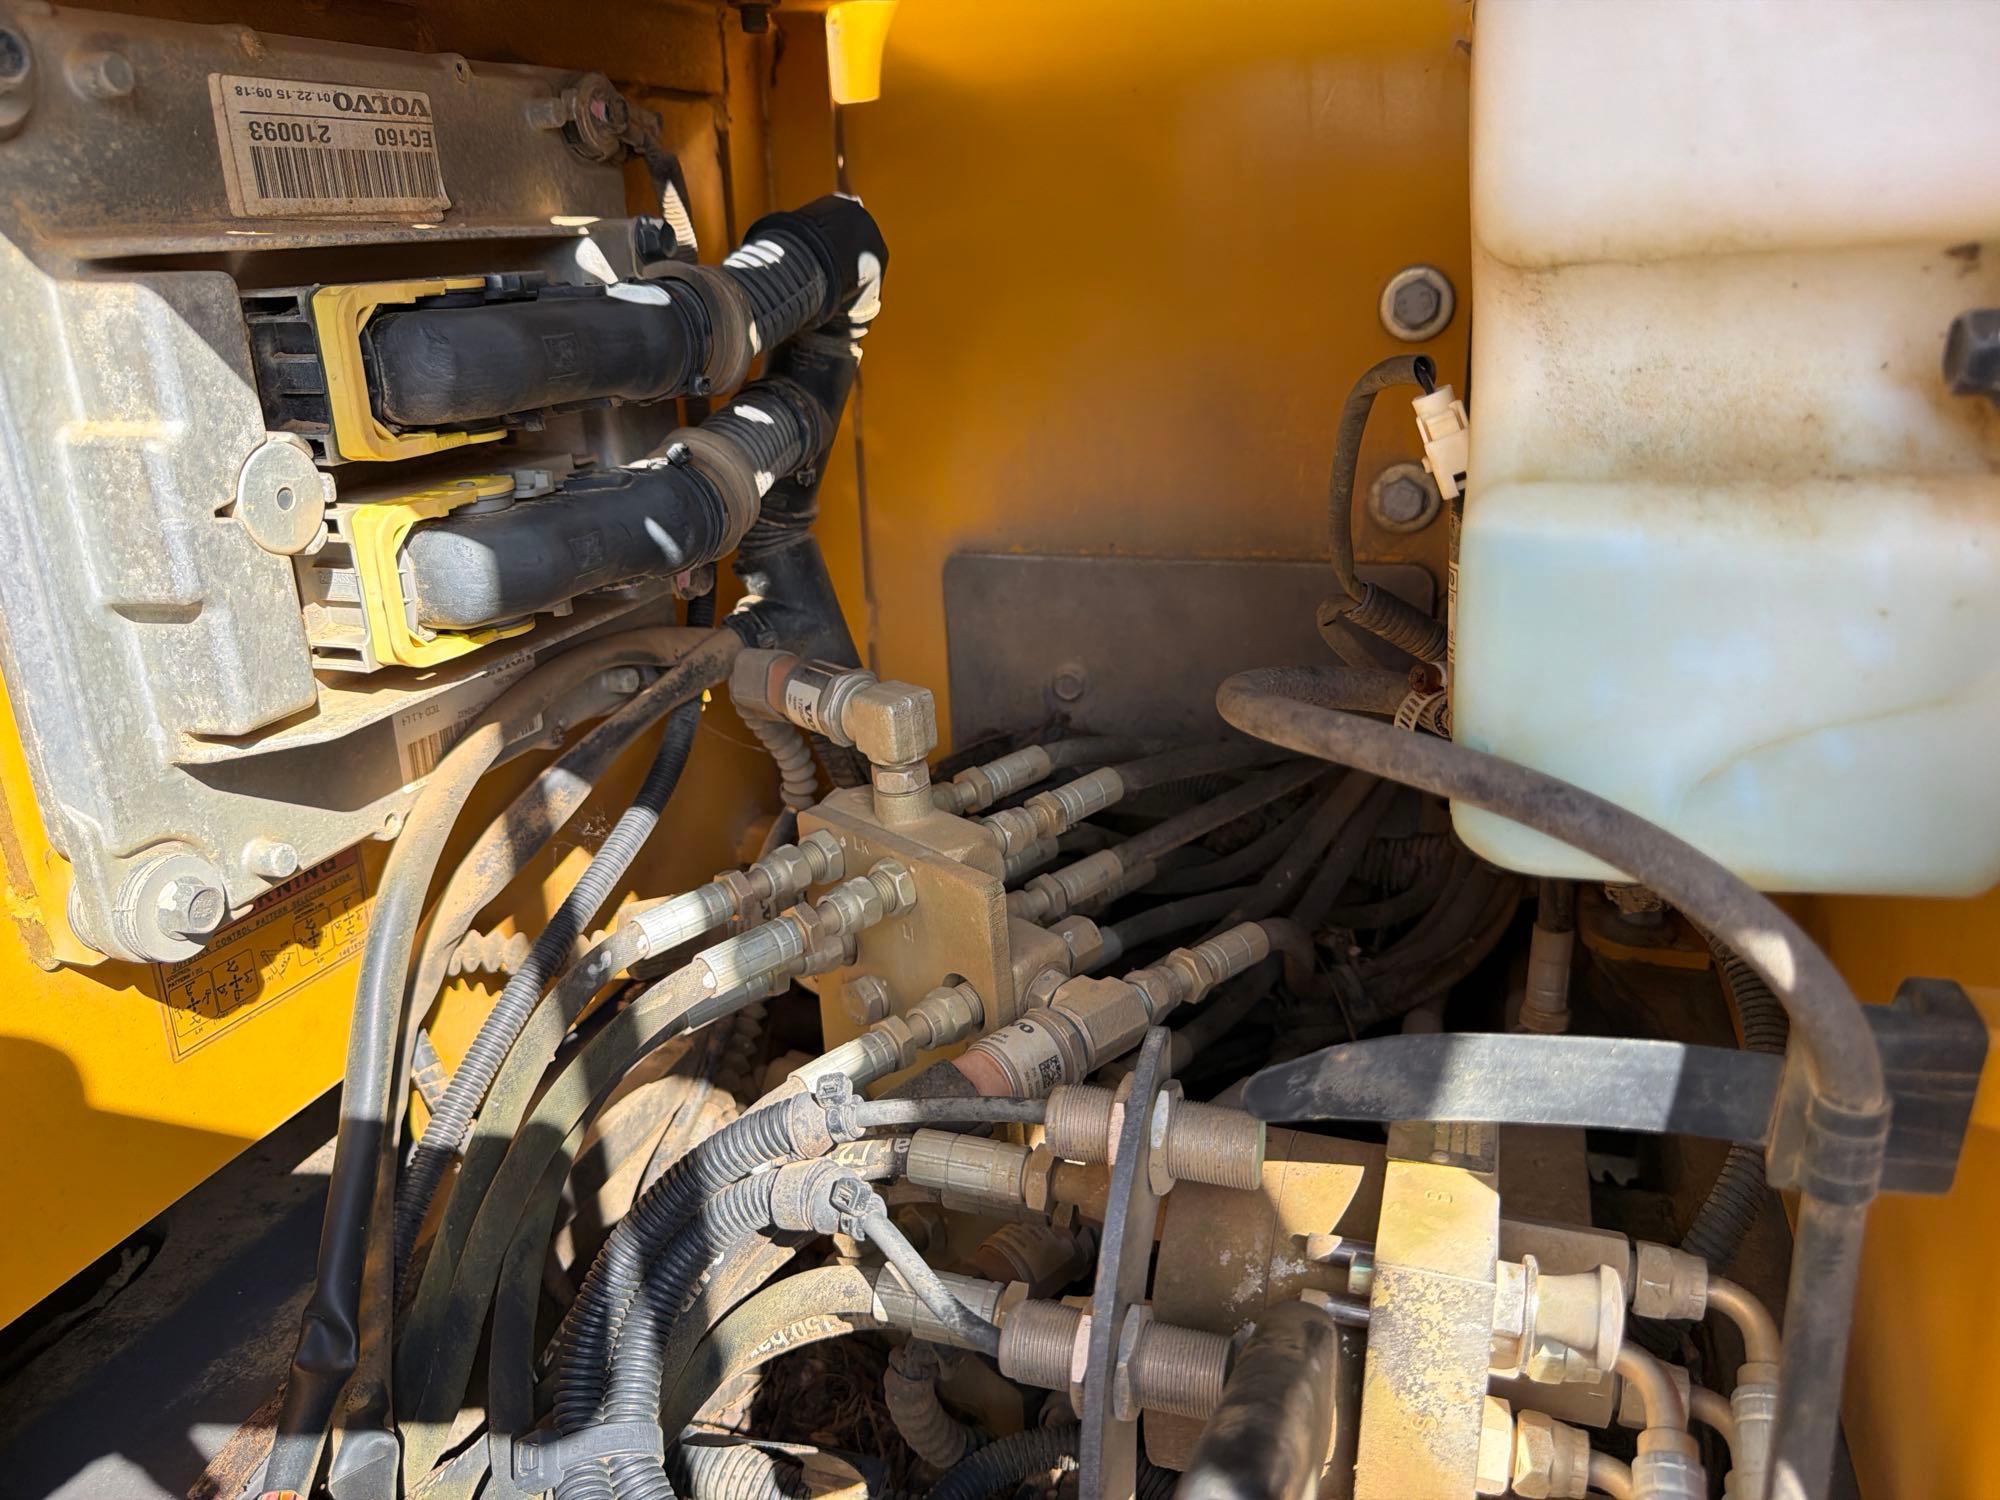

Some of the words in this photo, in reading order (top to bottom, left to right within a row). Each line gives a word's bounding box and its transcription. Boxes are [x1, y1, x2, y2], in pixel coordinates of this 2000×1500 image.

[234, 85, 272, 97] 09:18
[277, 88, 331, 102] 01.22.15
[332, 92, 430, 117] VOLVO
[248, 121, 332, 144] 210093
[374, 128, 433, 149] EC160
[215, 925, 251, 948] CONTROL
[255, 905, 289, 927] PATTERN
